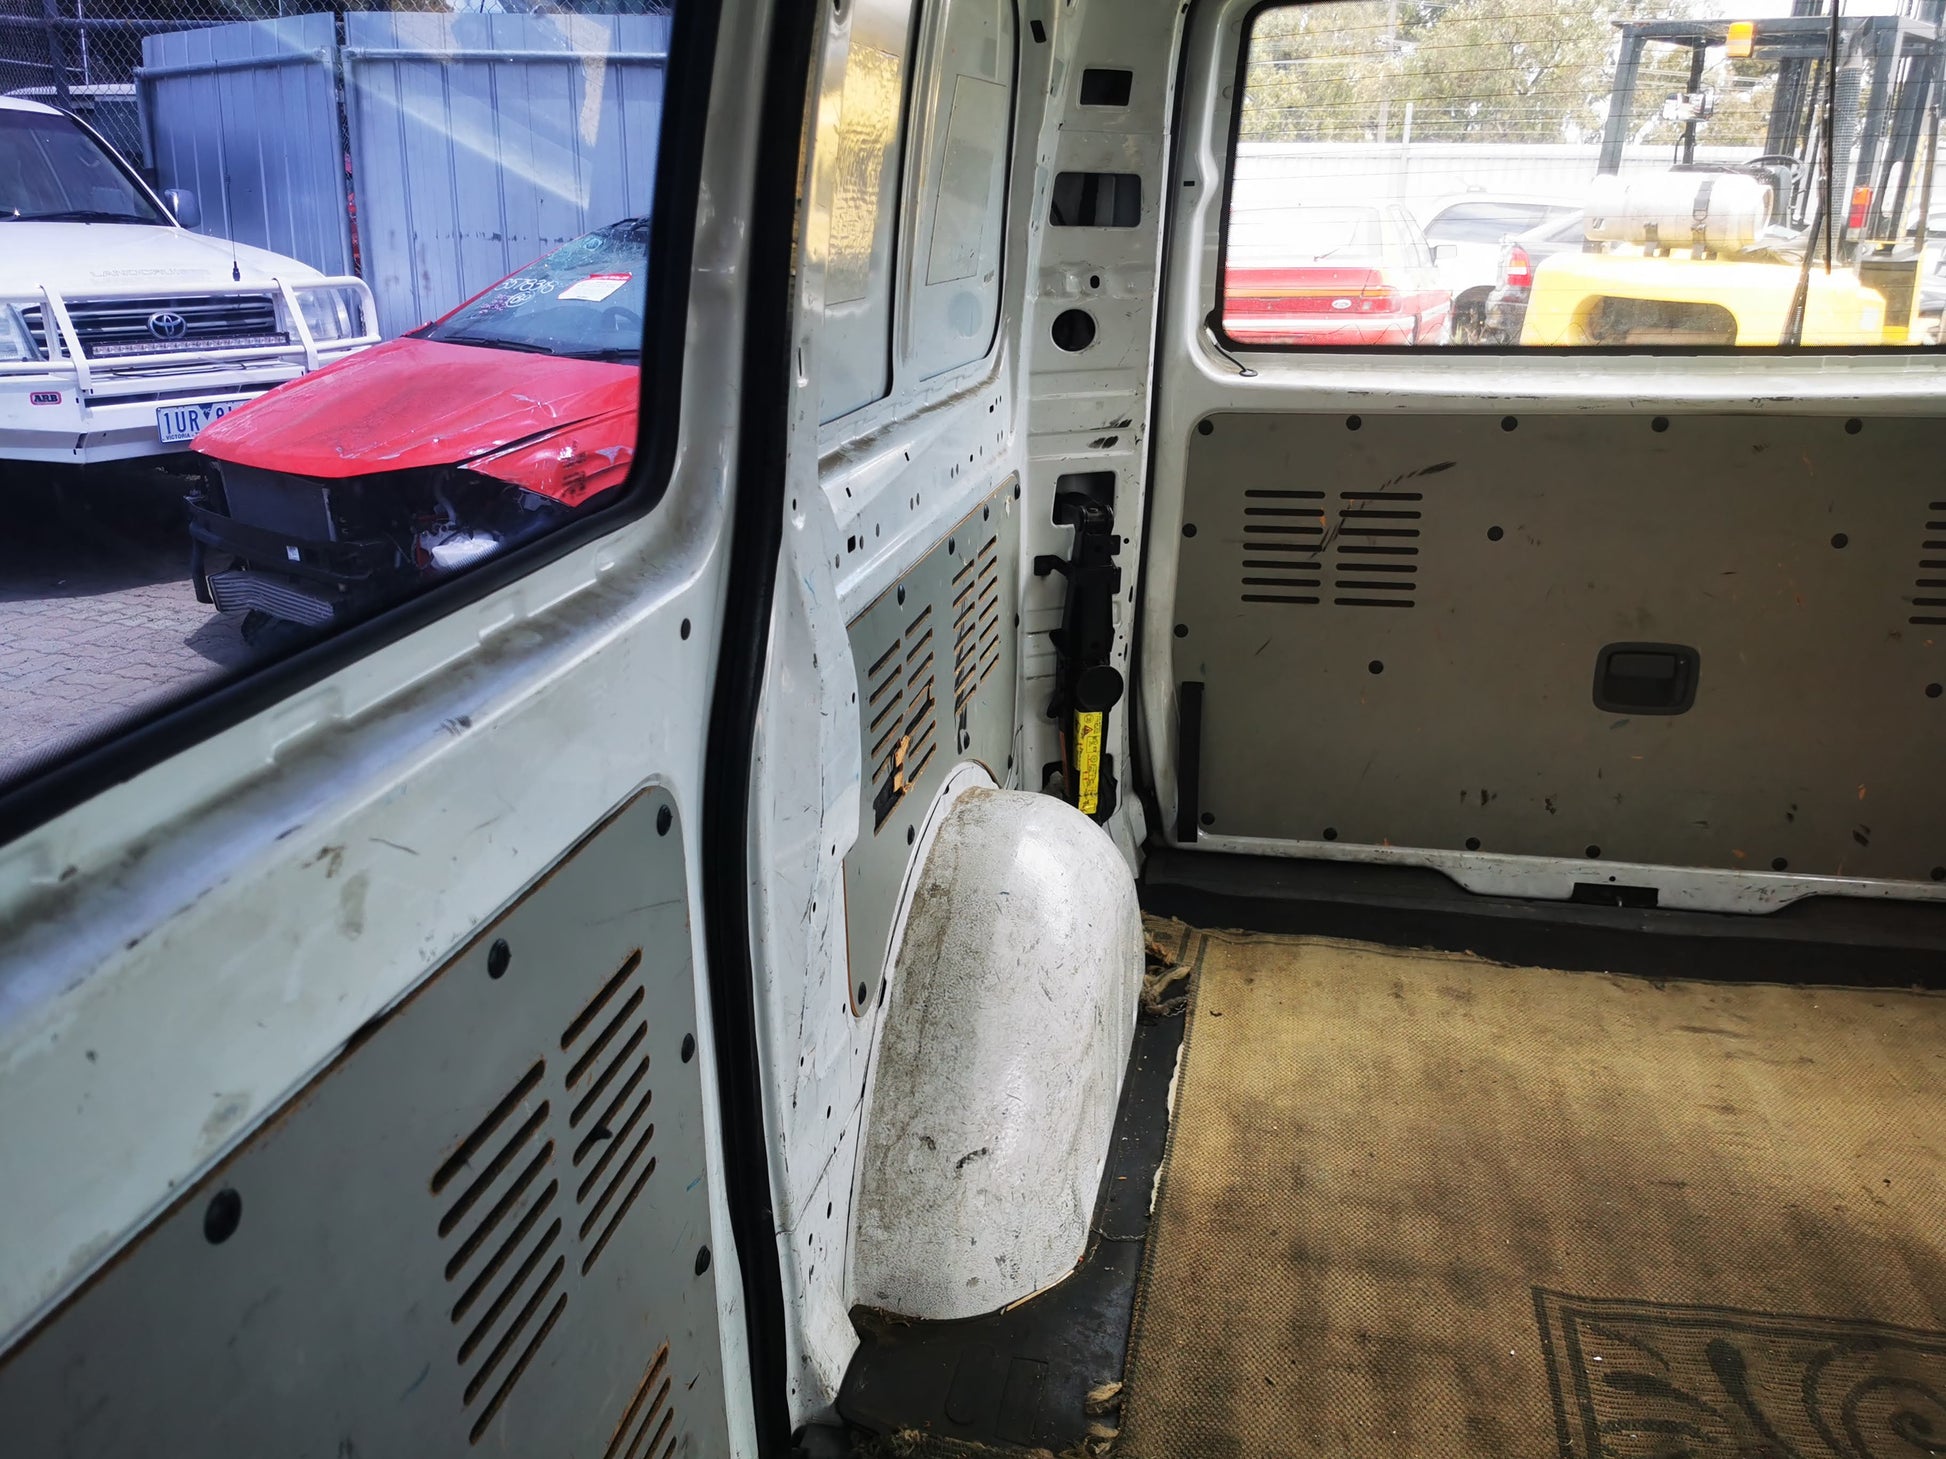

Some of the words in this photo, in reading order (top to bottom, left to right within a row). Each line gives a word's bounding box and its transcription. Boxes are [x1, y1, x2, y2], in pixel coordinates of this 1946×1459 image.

[34, 394, 58, 403] ARB
[164, 410, 200, 434] 1UR
[166, 432, 191, 440] VICTORIA
